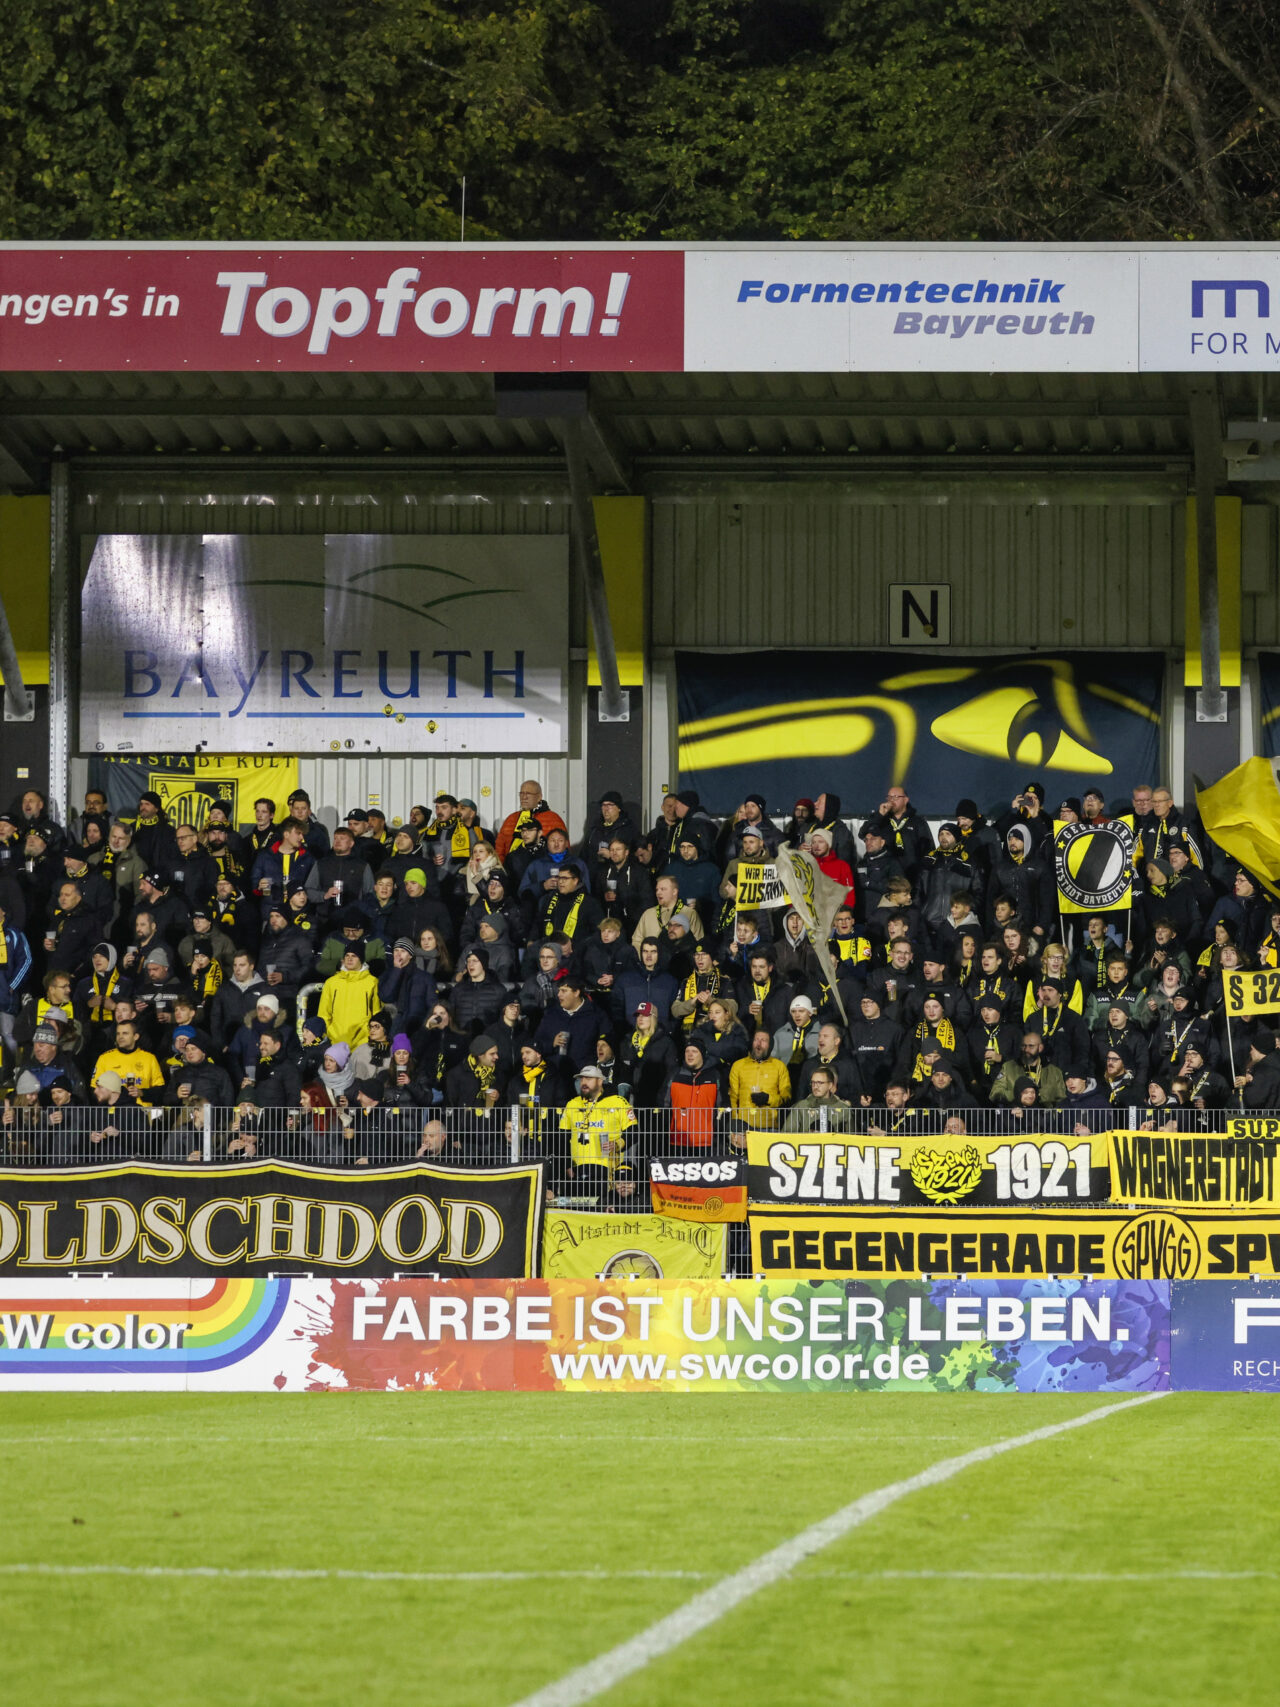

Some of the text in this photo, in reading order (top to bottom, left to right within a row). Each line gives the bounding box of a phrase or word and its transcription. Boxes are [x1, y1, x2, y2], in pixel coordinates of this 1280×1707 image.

[141, 287, 180, 317] in
[737, 278, 1066, 303] Formentechnik
[215, 268, 630, 354] Topform!
[893, 311, 1095, 338] Bayreuth
[1191, 332, 1248, 354] FOR
[901, 589, 938, 638] N
[762, 867, 778, 880] HAL
[1083, 879, 1126, 905] BAYREUTH
[767, 1140, 1091, 1201] SZENE 1921
[1113, 1135, 1277, 1203] WAGNERSTADT
[760, 1230, 1105, 1273] GEGENGERADE
[64, 1314, 193, 1350] color
[351, 1297, 1129, 1341] FARBE IST UNSER LEBEN.
[550, 1344, 929, 1382] www.swcolor.de
